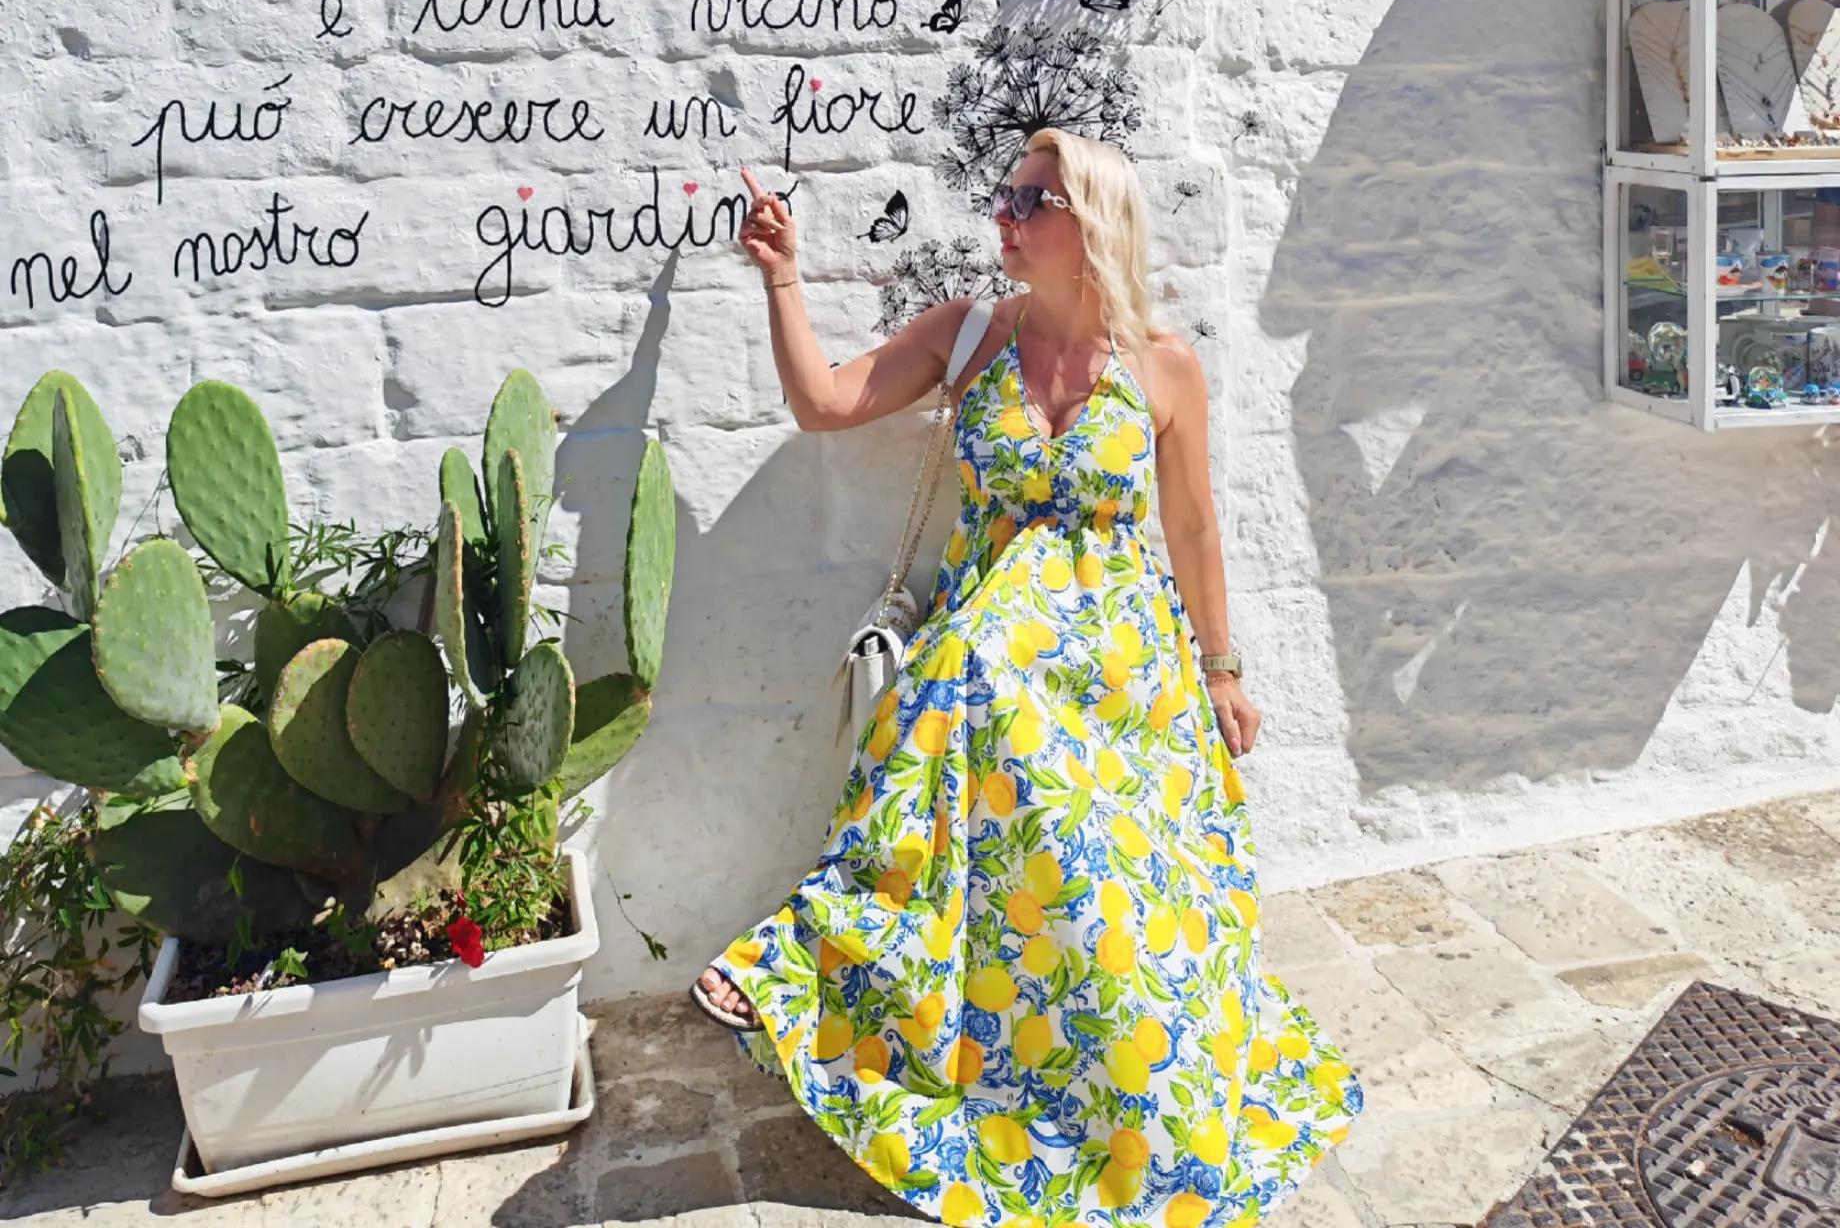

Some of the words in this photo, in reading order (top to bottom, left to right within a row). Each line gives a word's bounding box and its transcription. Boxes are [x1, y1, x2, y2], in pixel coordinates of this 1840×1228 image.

[348, 96, 605, 144] crescere
[643, 95, 737, 140] un
[771, 64, 925, 172] fiore
[10, 210, 133, 309] nel
[174, 192, 369, 281] nostro
